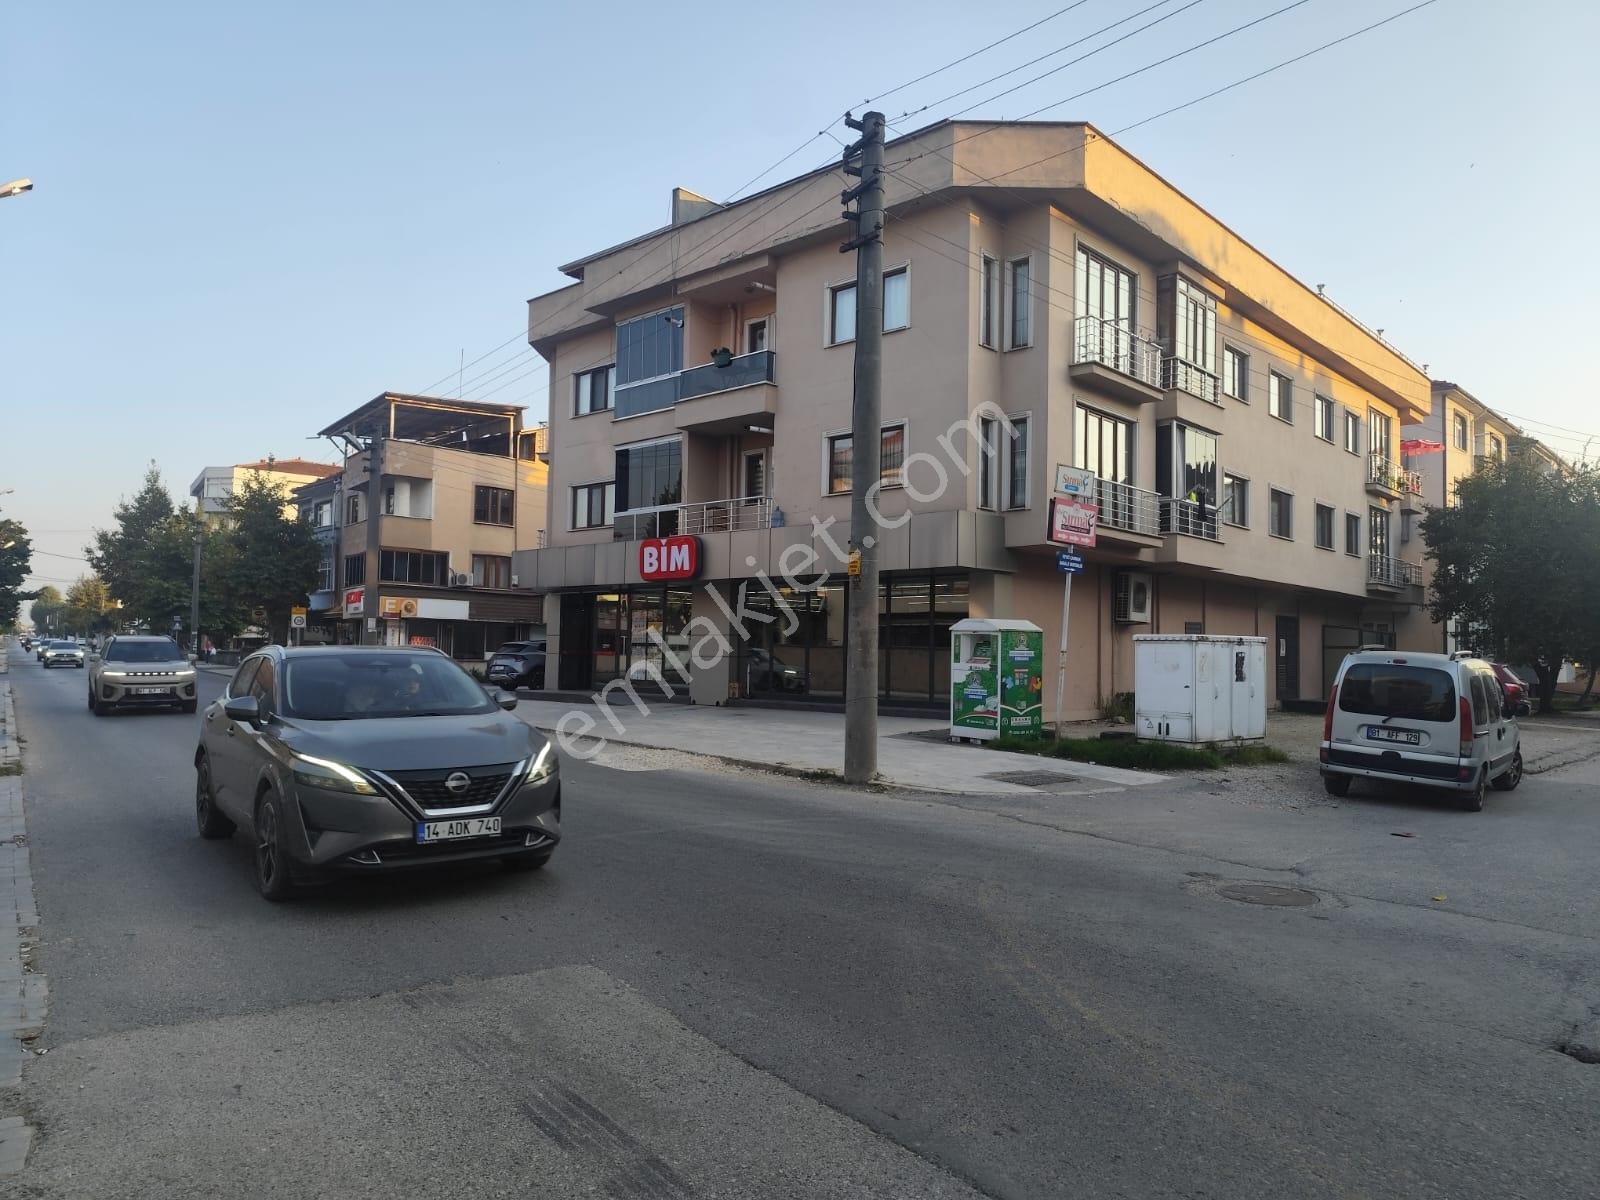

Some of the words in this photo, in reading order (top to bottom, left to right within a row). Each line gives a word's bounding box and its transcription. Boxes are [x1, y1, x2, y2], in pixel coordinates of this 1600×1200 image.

[643, 539, 690, 574] BİM
[426, 824, 440, 839] 14
[448, 821, 471, 837] ADK
[478, 818, 500, 834] 740
